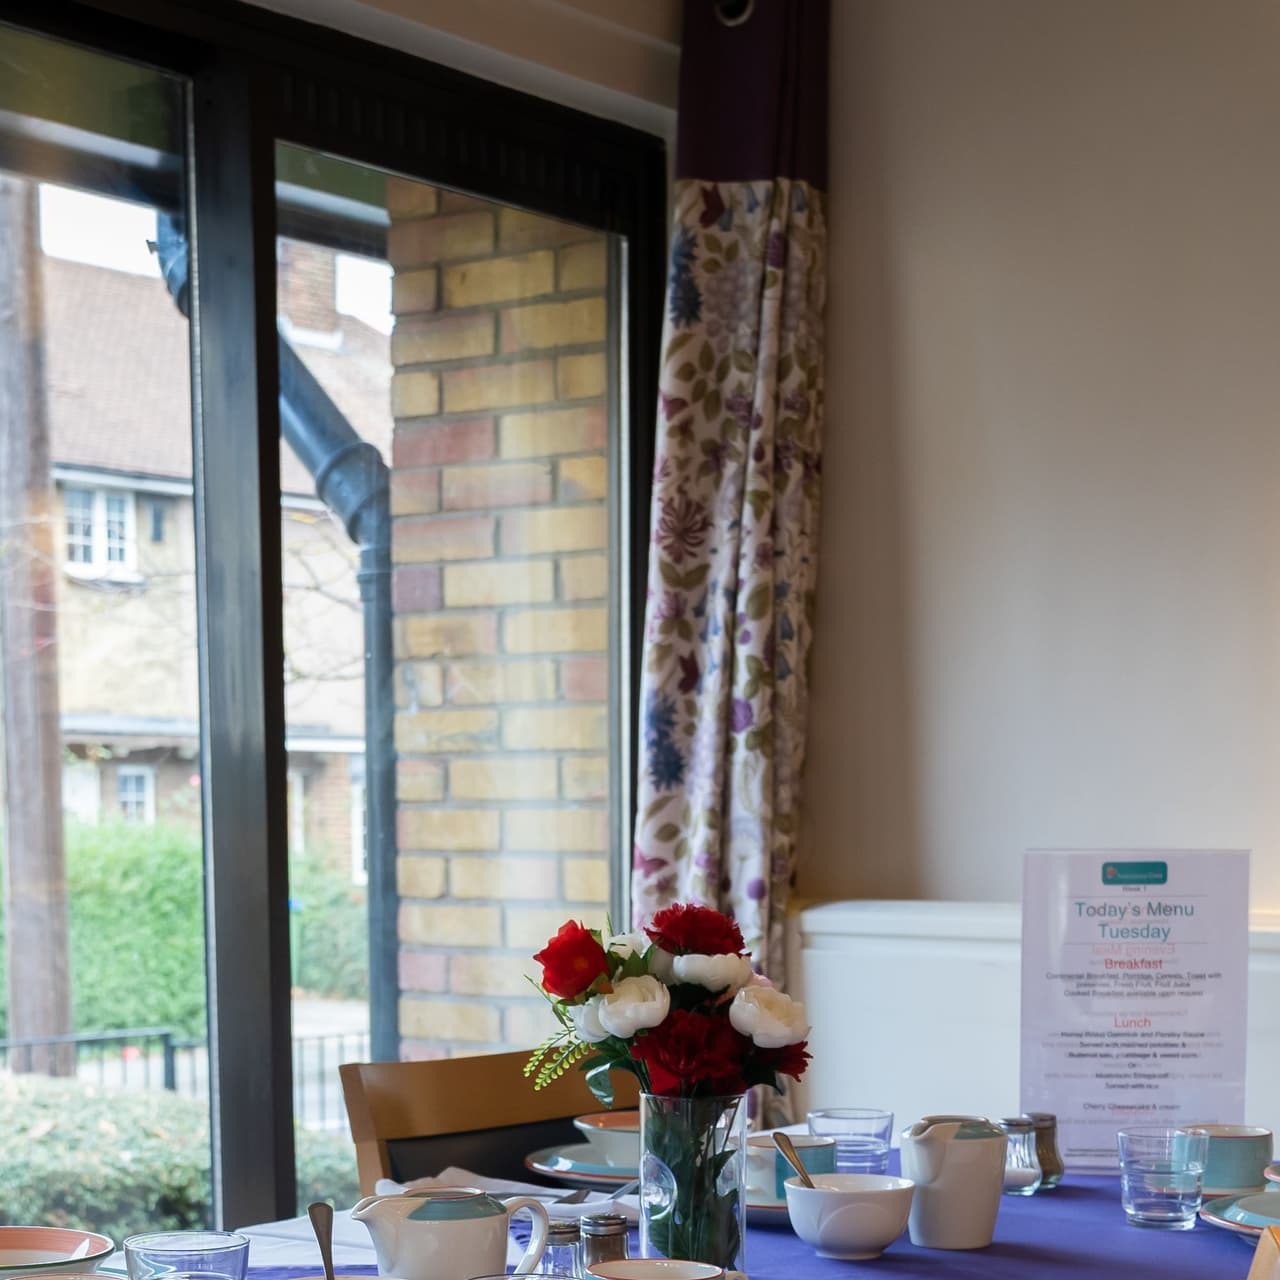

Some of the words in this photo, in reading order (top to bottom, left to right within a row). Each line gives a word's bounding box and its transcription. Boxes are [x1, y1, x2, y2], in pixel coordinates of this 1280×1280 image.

[1074, 901, 1141, 920] Today's
[1146, 901, 1195, 917] Menu
[1097, 923, 1171, 942] Tuesday
[1103, 958, 1163, 970] Breakfast
[1114, 1016, 1152, 1029] Lunch
